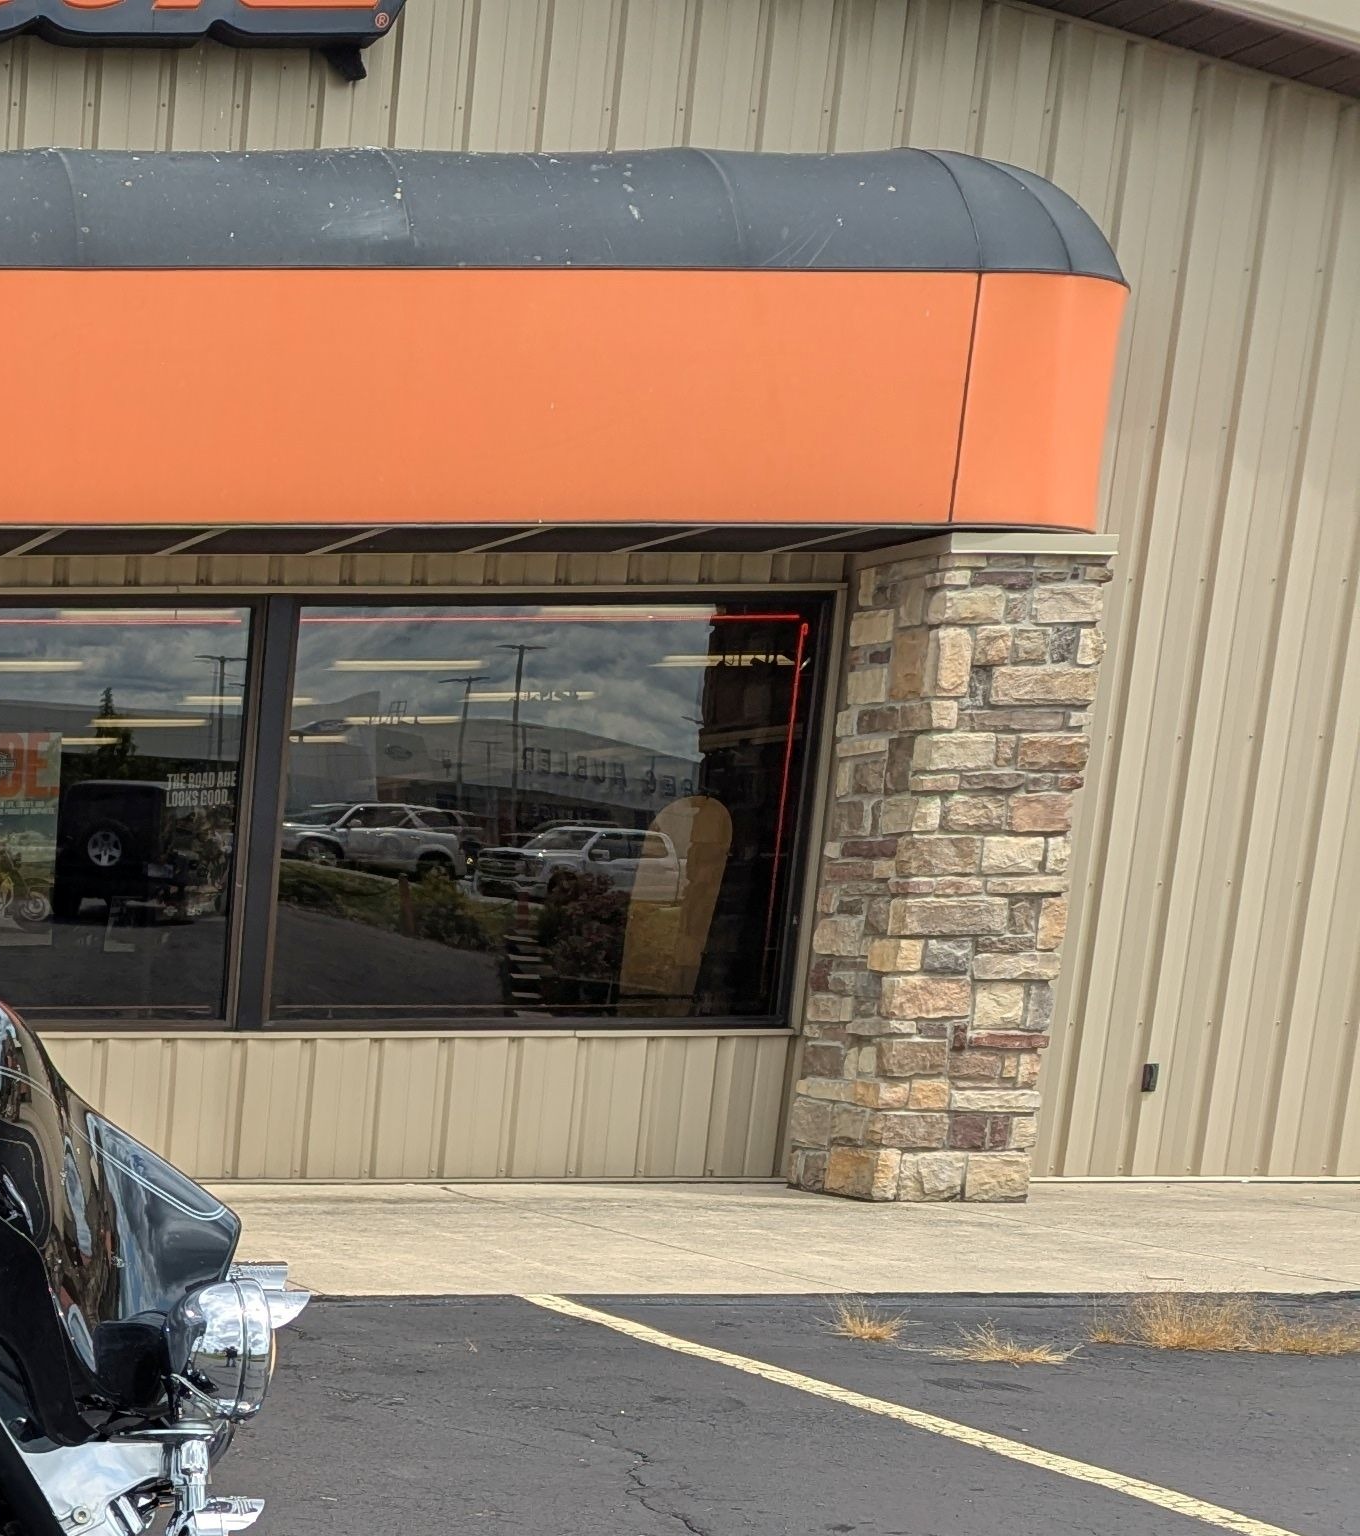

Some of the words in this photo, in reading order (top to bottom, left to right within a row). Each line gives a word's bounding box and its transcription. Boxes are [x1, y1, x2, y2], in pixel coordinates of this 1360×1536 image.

[166, 772, 187, 789] THE
[188, 771, 215, 789] ROAD
[166, 790, 199, 807] LOOKS
